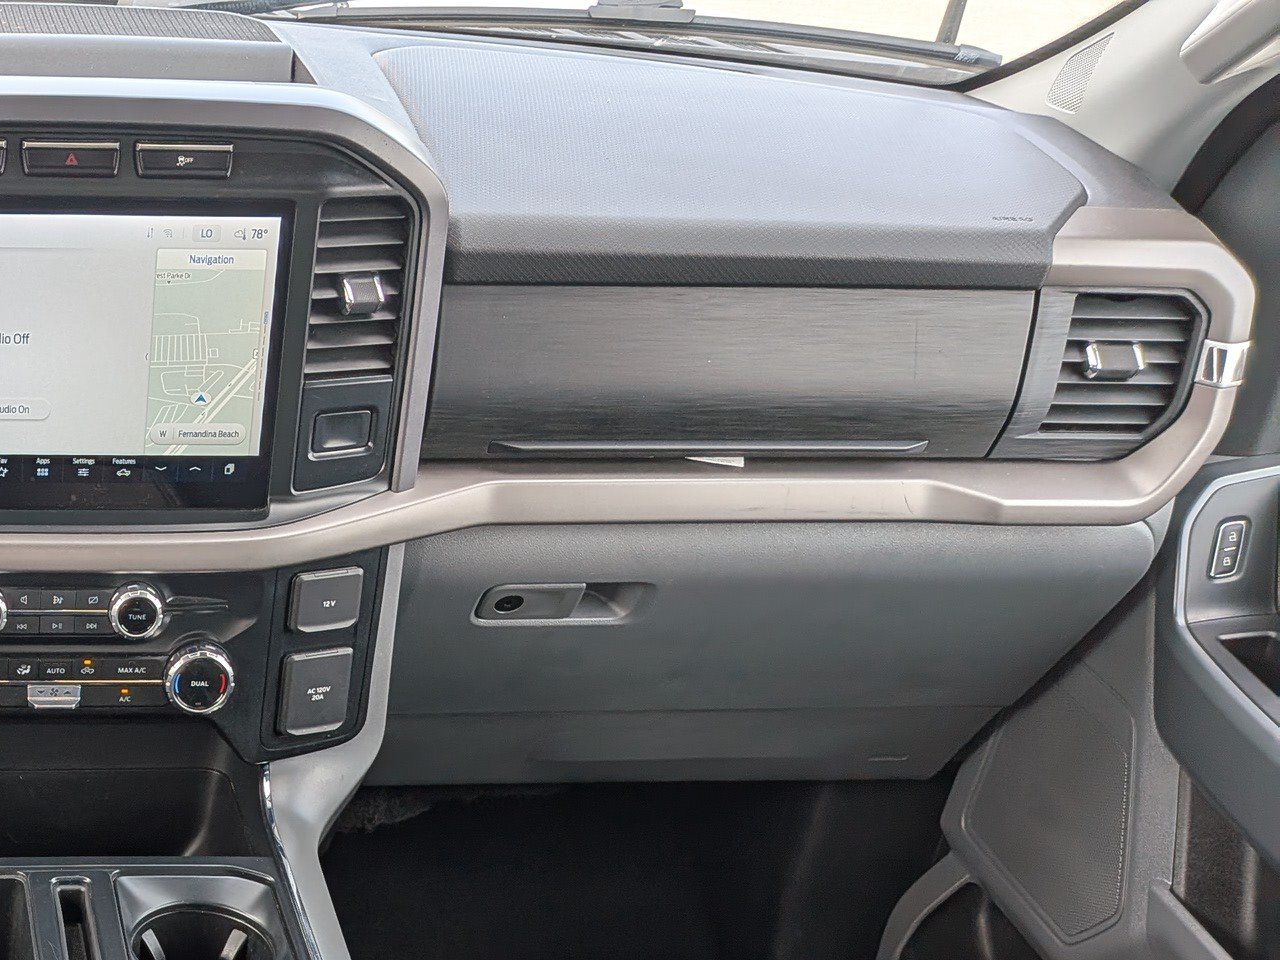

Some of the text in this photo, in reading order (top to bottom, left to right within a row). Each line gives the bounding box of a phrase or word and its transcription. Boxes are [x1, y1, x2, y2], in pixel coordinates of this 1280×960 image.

[200, 229, 213, 239] LO
[189, 254, 235, 265] Navigation
[13, 332, 30, 344] Off
[18, 404, 30, 414] On
[159, 429, 240, 439] W Fernandina Beach
[36, 457, 51, 465] Apps
[72, 457, 95, 466] Settings
[112, 457, 136, 465] Features
